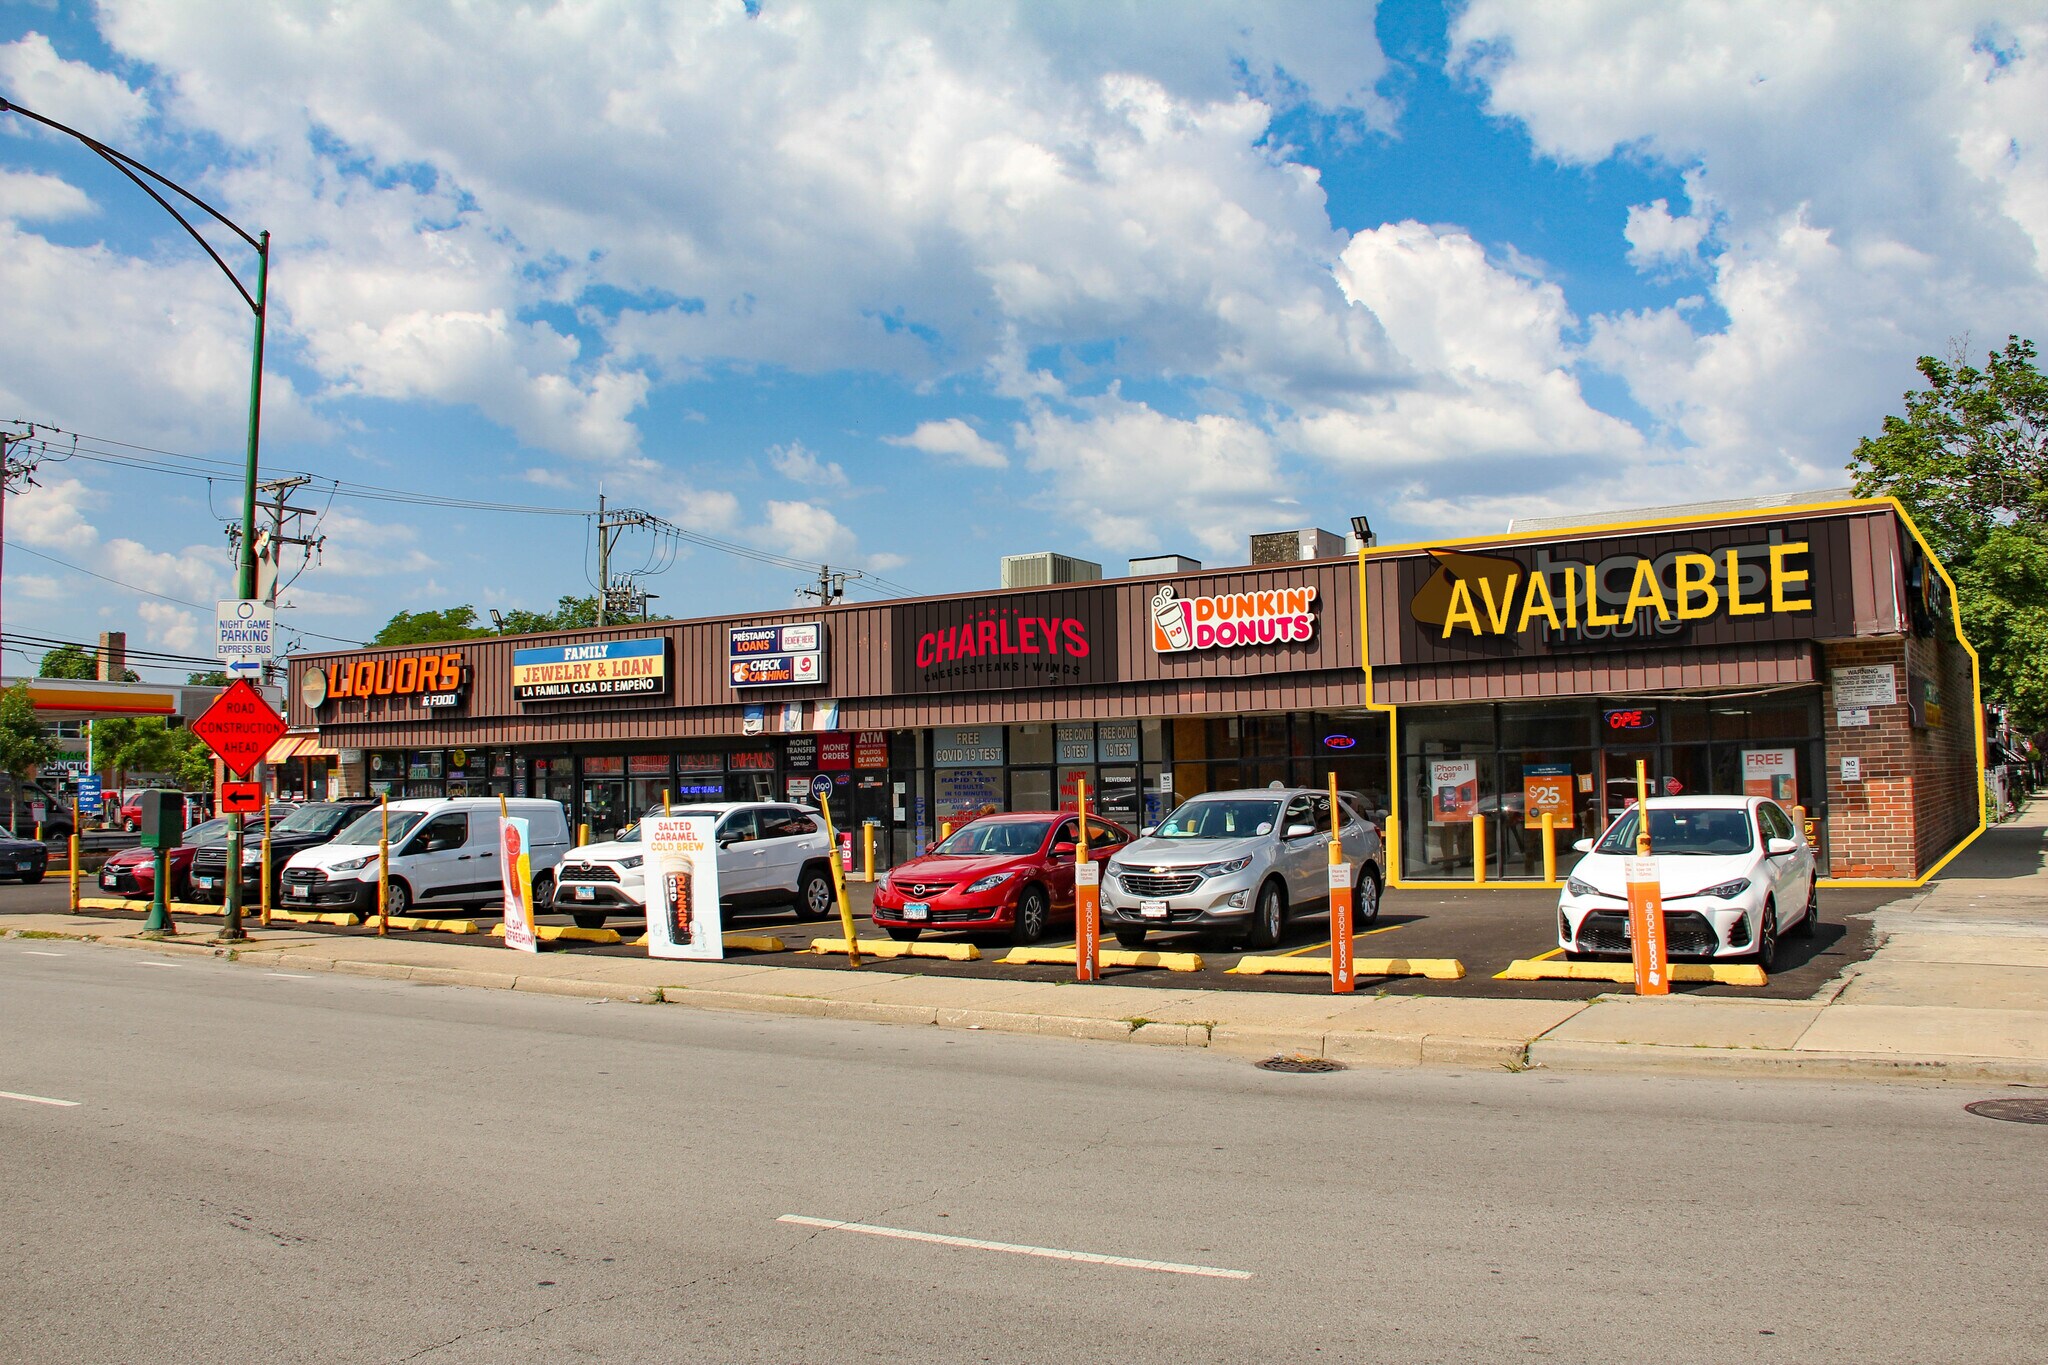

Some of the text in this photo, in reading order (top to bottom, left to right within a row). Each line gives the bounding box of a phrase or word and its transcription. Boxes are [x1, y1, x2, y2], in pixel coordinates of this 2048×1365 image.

[1196, 589, 1314, 621] DUNKIN'
[220, 620, 270, 629] NIGHT GAME
[1542, 605, 1687, 644] mobile
[222, 630, 268, 641] PARKING
[732, 630, 775, 641] PRÉSTAMOS
[1170, 626, 1182, 637] DD
[1197, 615, 1310, 647] DONUTS
[737, 640, 770, 652] LOANS
[784, 635, 814, 645] RENEW HERE
[916, 617, 1090, 668] CHARLEYS
[218, 645, 271, 654] EXPRESS BUS
[564, 645, 609, 660] FAMILY
[523, 658, 654, 683] JEWELRY & LOAN
[750, 659, 781, 671] CHECK
[328, 653, 462, 699] LIQUORS
[924, 662, 1081, 683] CHEESESTEAKS WINGS
[522, 677, 654, 697] LA FAMILIA CASA DE EMPEÑO
[422, 694, 456, 706] & FOOD
[226, 703, 255, 713] ROAD
[200, 722, 279, 733] CONSTRUCTION
[1100, 726, 1137, 740] FREE COVID
[859, 732, 883, 744] ATM
[956, 732, 980, 745] FREE
[1058, 728, 1094, 740] FREE COVID
[224, 742, 258, 753] AHEAD
[1326, 738, 1352, 747] OPEN
[936, 748, 1001, 761] COVID 19 TEST
[1063, 745, 1088, 758] 19 TEST
[1106, 744, 1131, 756] 19 TEST
[44, 761, 89, 770] JUNCTIO
[1746, 754, 1783, 766] FREE
[1434, 764, 1462, 773] iPhone
[1067, 771, 1087, 782] JUST
[814, 782, 830, 791] vigo
[1529, 785, 1560, 804] $25
[658, 822, 692, 830] SALTED
[654, 832, 698, 841] CARAMEL
[651, 842, 704, 851] COLD BREW
[668, 875, 677, 902] ICED
[512, 920, 522, 931] DAY
[1645, 902, 1658, 970] boost mobile
